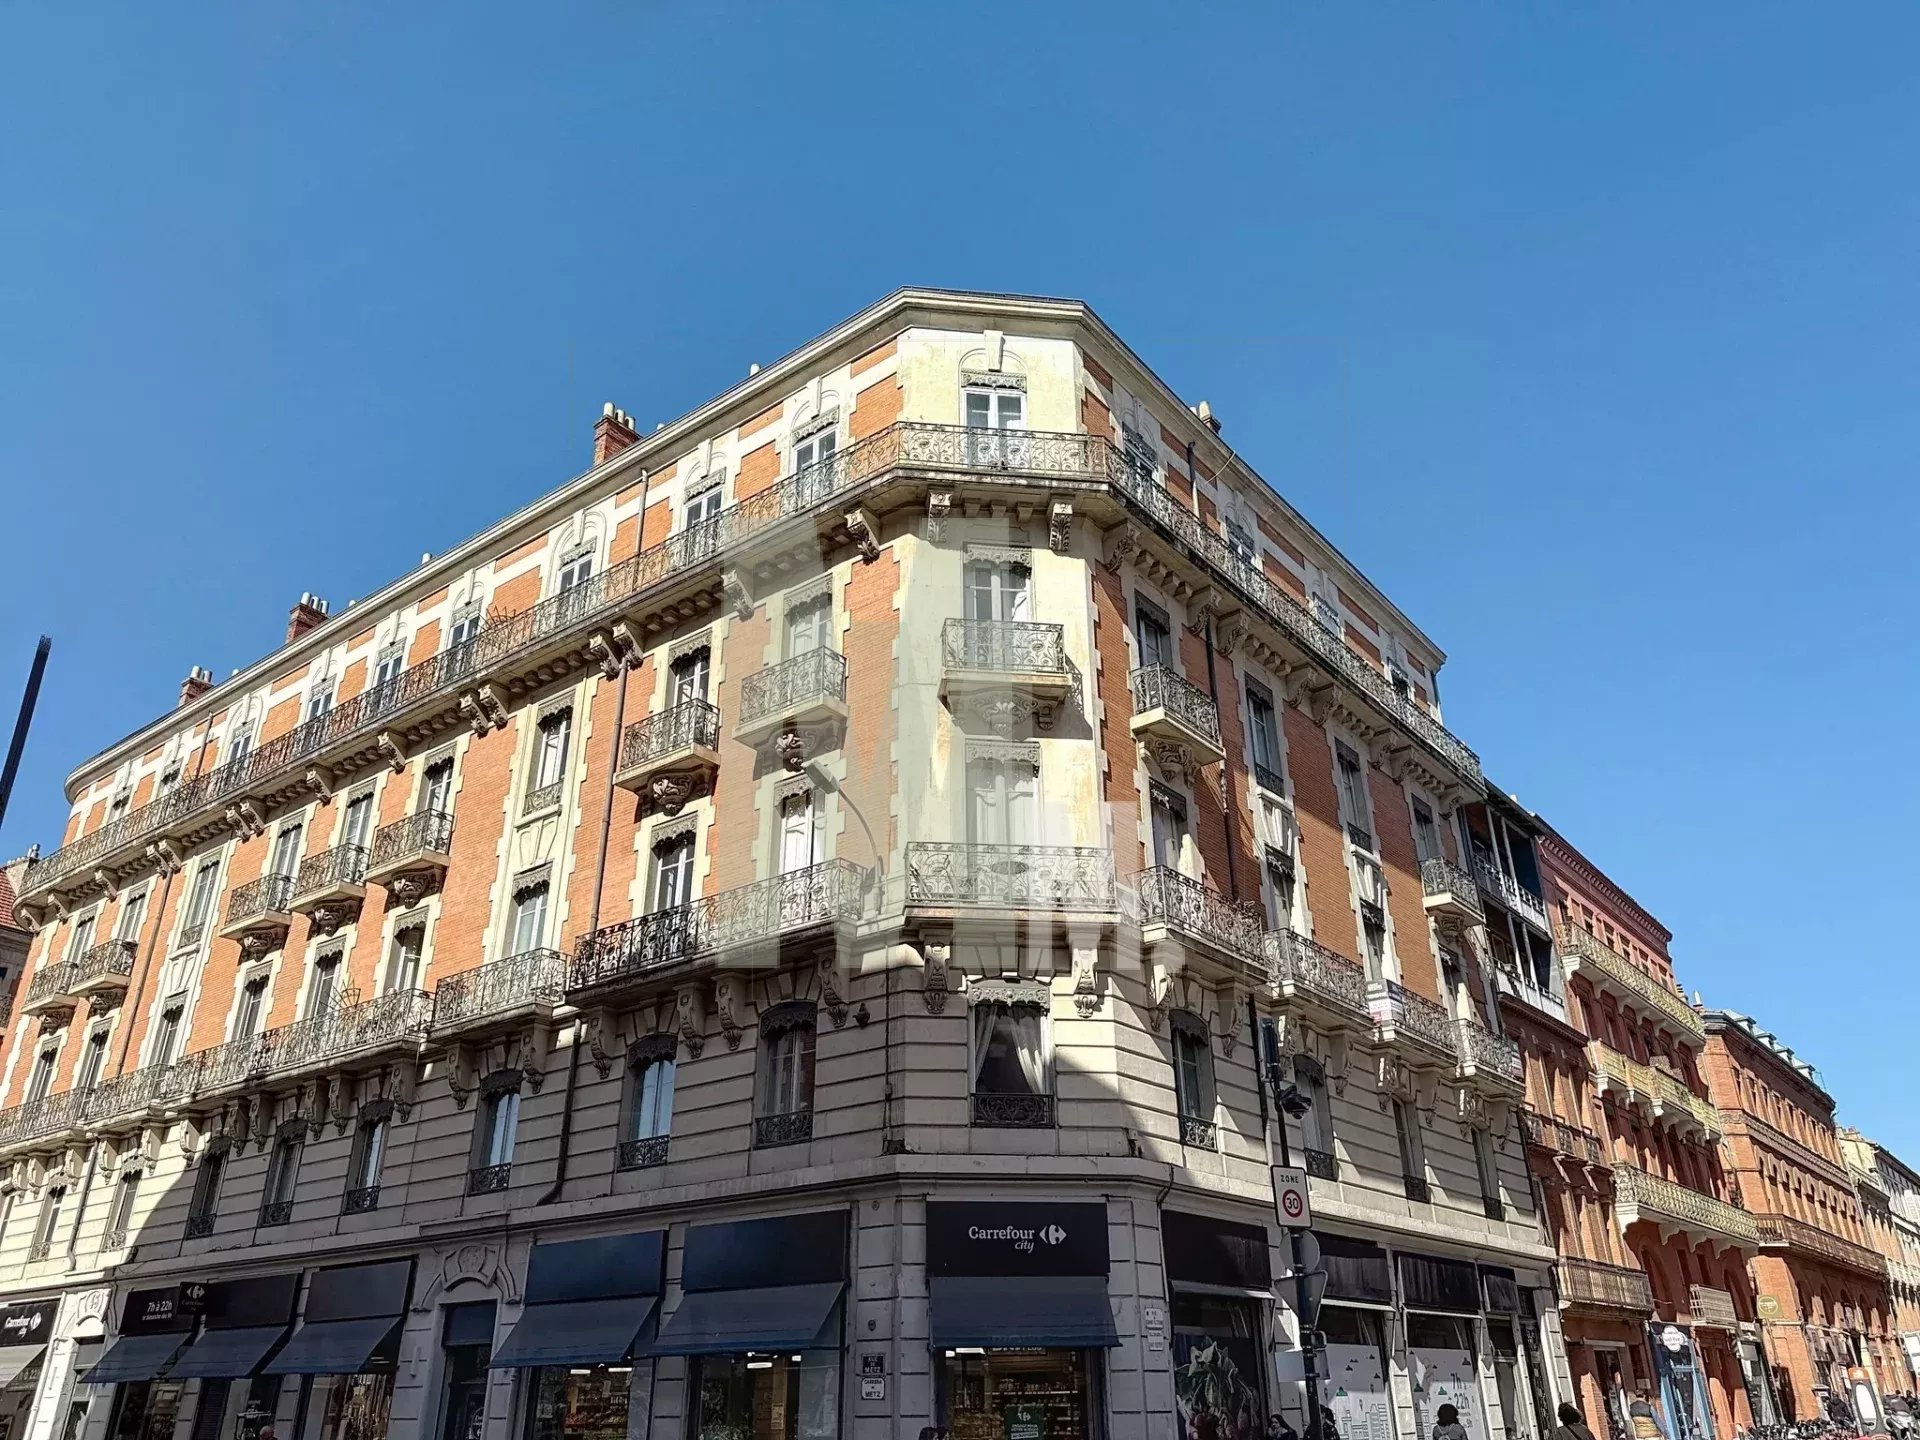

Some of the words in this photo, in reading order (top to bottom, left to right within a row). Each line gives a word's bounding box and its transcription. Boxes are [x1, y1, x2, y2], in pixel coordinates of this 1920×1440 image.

[1280, 1174, 1299, 1184] ZONE
[1286, 1197, 1299, 1210] 30
[968, 1225, 1035, 1239] Carrefour
[1014, 1240, 1035, 1254] city
[147, 1301, 155, 1313] 7h
[160, 1299, 173, 1312] 22h
[4, 1314, 31, 1329] Carrefour
[1450, 1373, 1463, 1390] 7h
[1454, 1392, 1471, 1410] 22h
